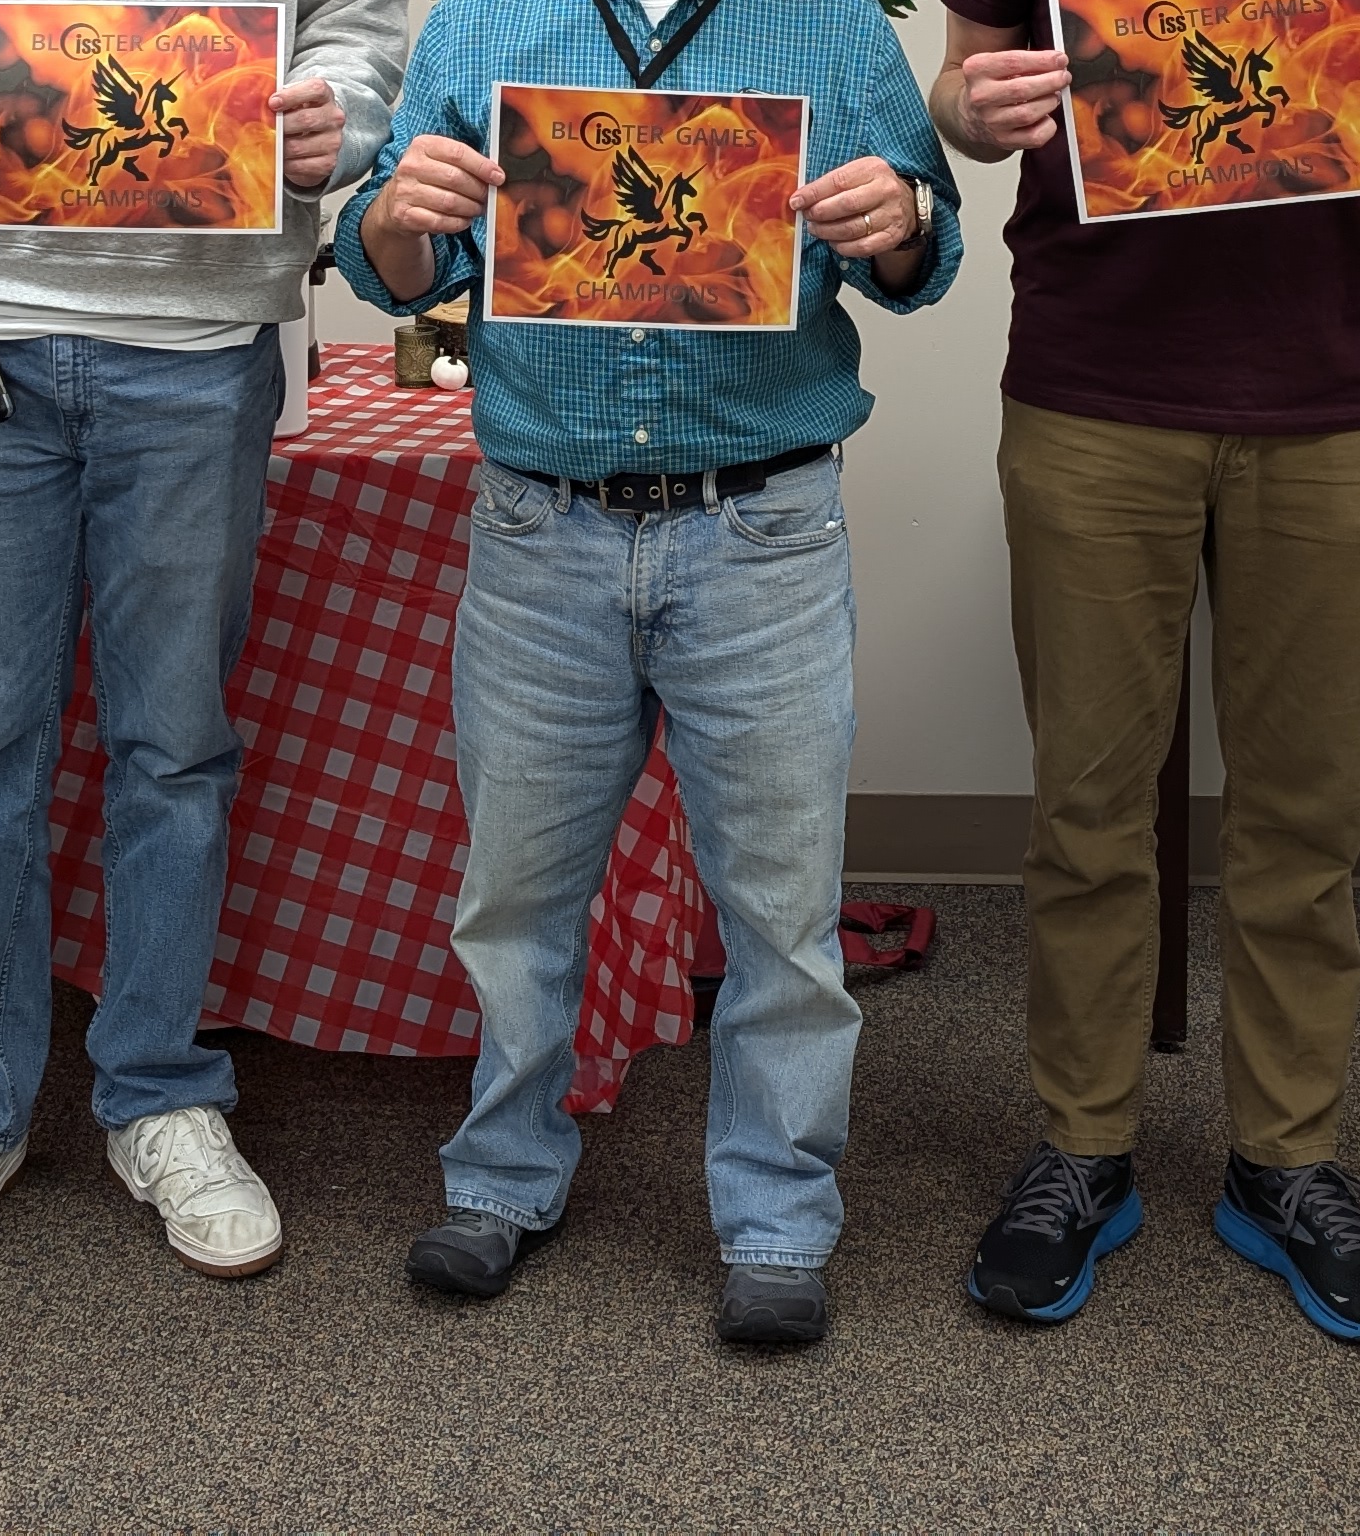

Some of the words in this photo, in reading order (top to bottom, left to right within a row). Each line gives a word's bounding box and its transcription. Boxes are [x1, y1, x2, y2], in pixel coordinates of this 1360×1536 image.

[155, 33, 236, 53] GAMES
[676, 126, 758, 149] GAMES
[1166, 156, 1314, 189] CHAMPIONS
[60, 188, 203, 208] CHAMPIONS
[575, 280, 719, 305] CHAMPIONS
